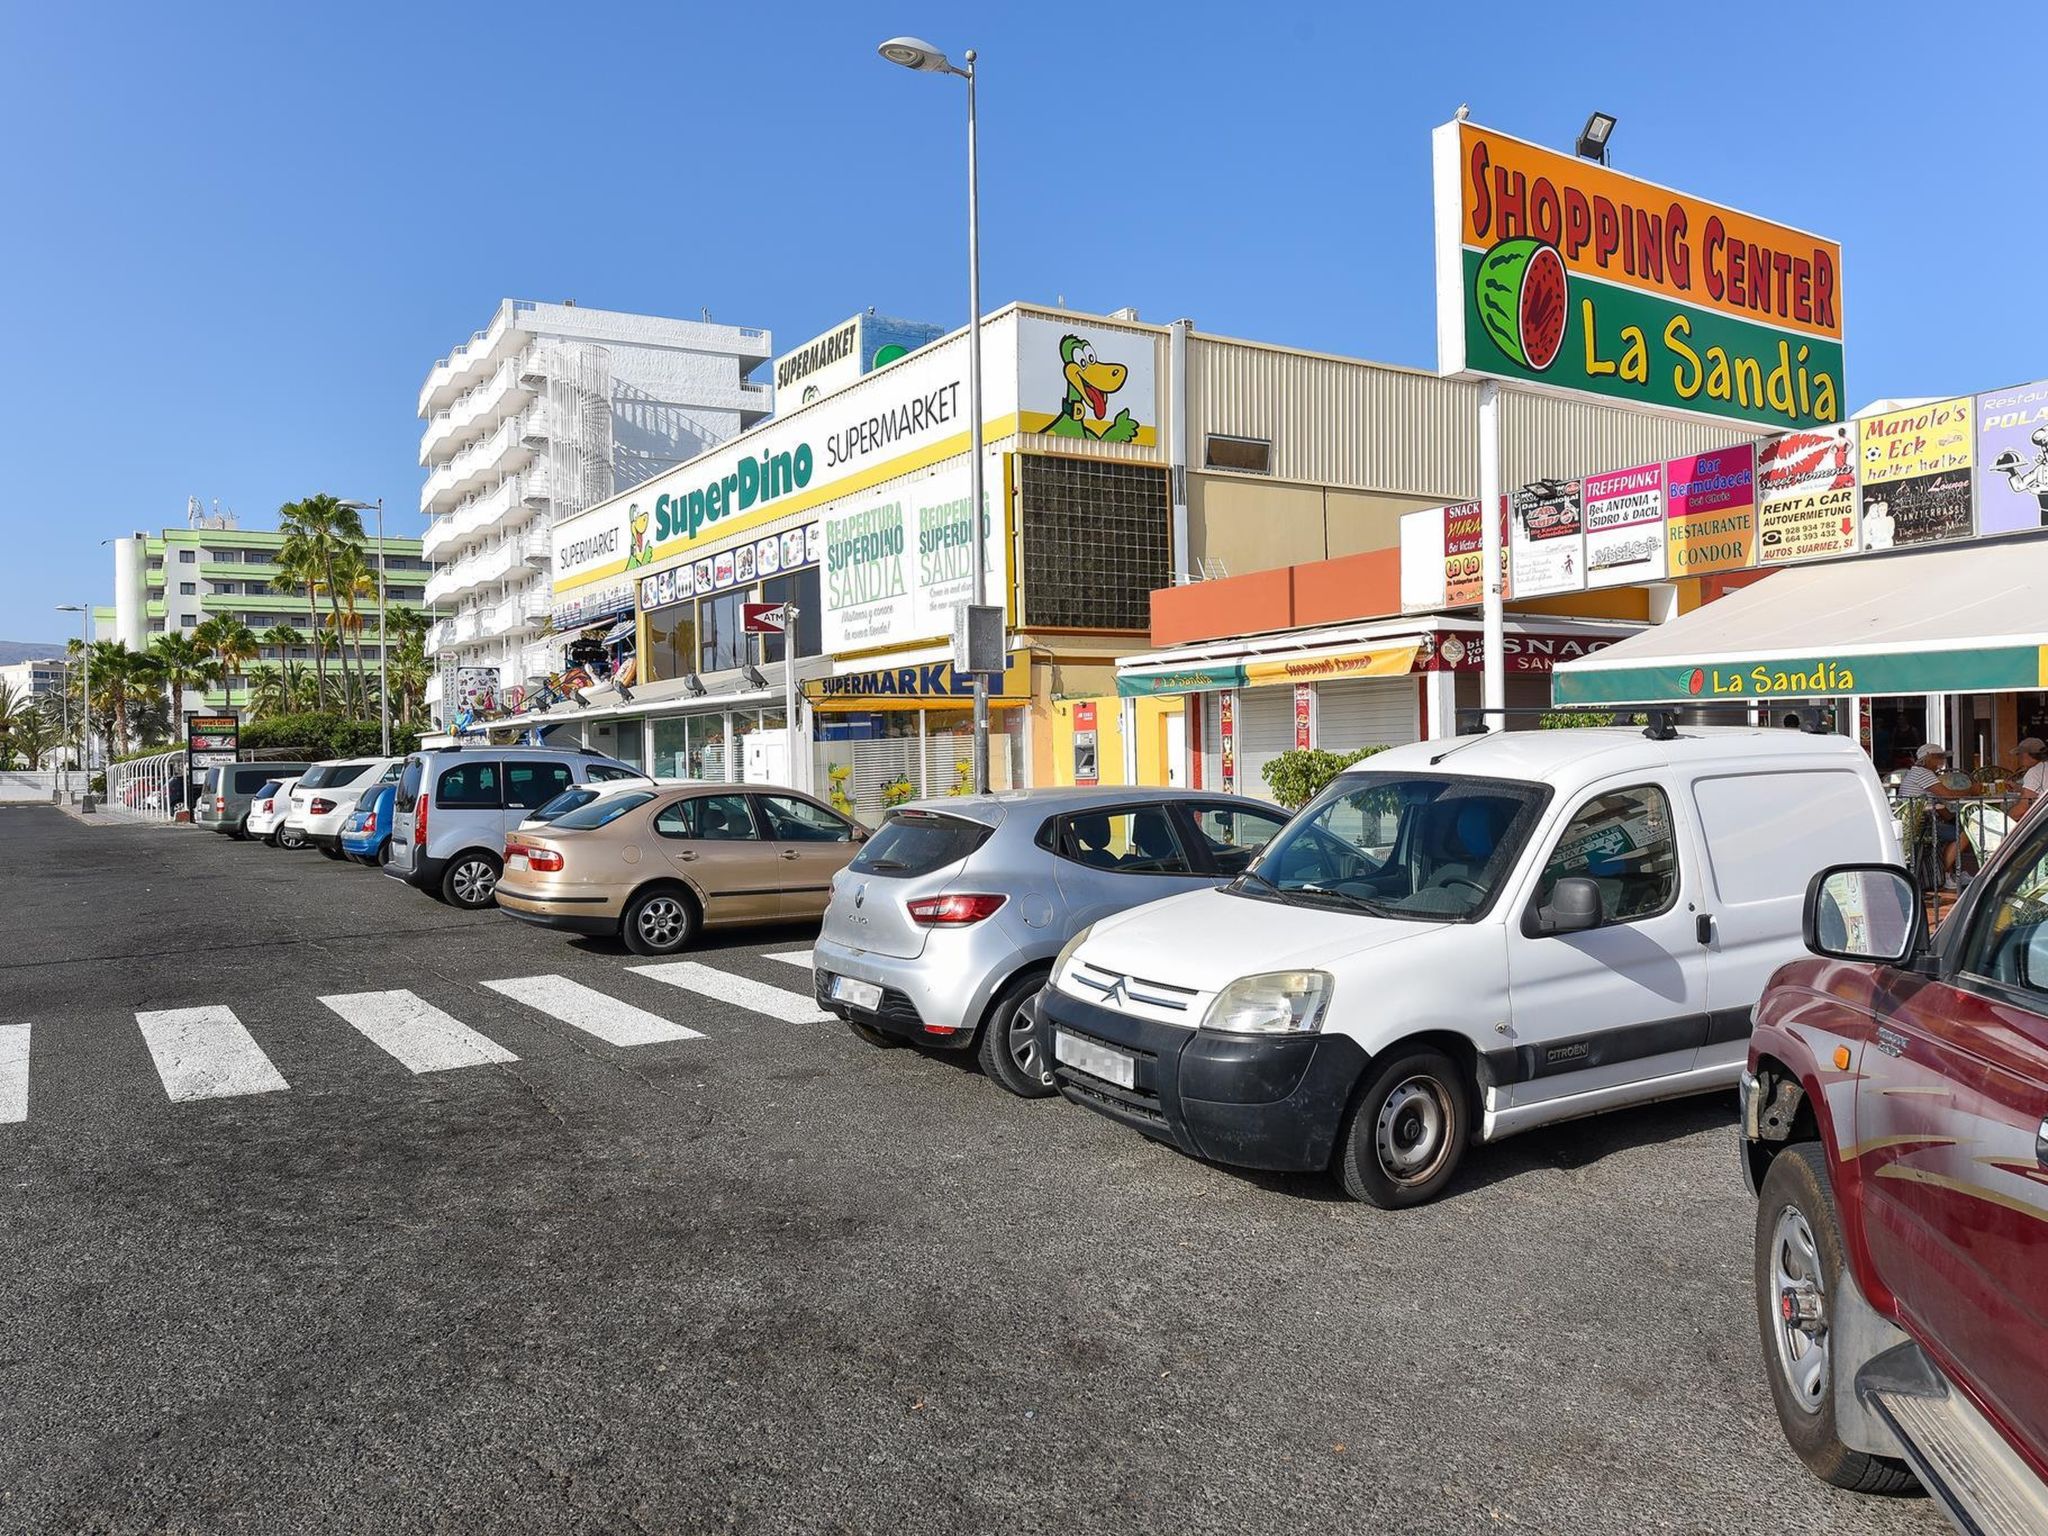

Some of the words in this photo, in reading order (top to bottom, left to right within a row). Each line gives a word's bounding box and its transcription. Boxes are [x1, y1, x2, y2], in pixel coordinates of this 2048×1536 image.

[1471, 141, 1690, 290] SHOPPING
[1702, 216, 1835, 328] CENTER
[777, 323, 856, 390] SUPERMARKET
[1582, 298, 1648, 384] La
[1663, 314, 1837, 422] Sandía
[1866, 404, 1966, 440] Manolo's
[1888, 436, 1926, 459] Eck
[1698, 458, 1720, 474] Bar
[1920, 454, 1967, 471] halbe
[561, 526, 619, 569] SUPERMARKET
[656, 442, 813, 541] SuperDino
[827, 381, 961, 467] SUPERMARKET
[1587, 470, 1660, 498] TREFFPUNKT
[1669, 469, 1751, 498] Bermudaeck
[1760, 479, 1795, 491] Sweet
[1795, 465, 1854, 485] Moments
[1928, 476, 1970, 492] Lounge
[1449, 502, 1480, 518] SNACK
[1589, 503, 1604, 517] Bei
[1605, 494, 1649, 513] ANTONIA
[1763, 499, 1802, 515] RENT
[1805, 497, 1815, 508] A
[1820, 491, 1852, 505] CAR
[826, 501, 903, 545] REAPERTURA
[1589, 513, 1620, 528] ISIDRO
[1622, 511, 1630, 521] &
[1632, 506, 1659, 520] DACIL
[1670, 514, 1751, 540] RESTAURANTE
[1763, 505, 1852, 527] AUTOVERMIETUNG
[1785, 526, 1800, 535] 928
[1802, 524, 1818, 532] 934
[1821, 521, 1836, 530] 782
[919, 514, 991, 554] SUPERDIO
[1460, 539, 1477, 552] Victor
[1785, 534, 1800, 543] 664
[1802, 533, 1818, 541] 393
[1821, 529, 1836, 538] 432
[827, 525, 904, 572] SUPERDINO
[1679, 541, 1742, 566] CONDOR
[1764, 547, 1793, 559] AUTOS
[921, 541, 993, 586] SANDA
[1446, 558, 1461, 578] LA
[1463, 555, 1480, 576] LA
[828, 554, 905, 609] SANDIA
[764, 613, 784, 621] ATM
[1712, 670, 1743, 693] La
[1750, 661, 1854, 693] Sandía
[1547, 1044, 1586, 1060] CITROËN
